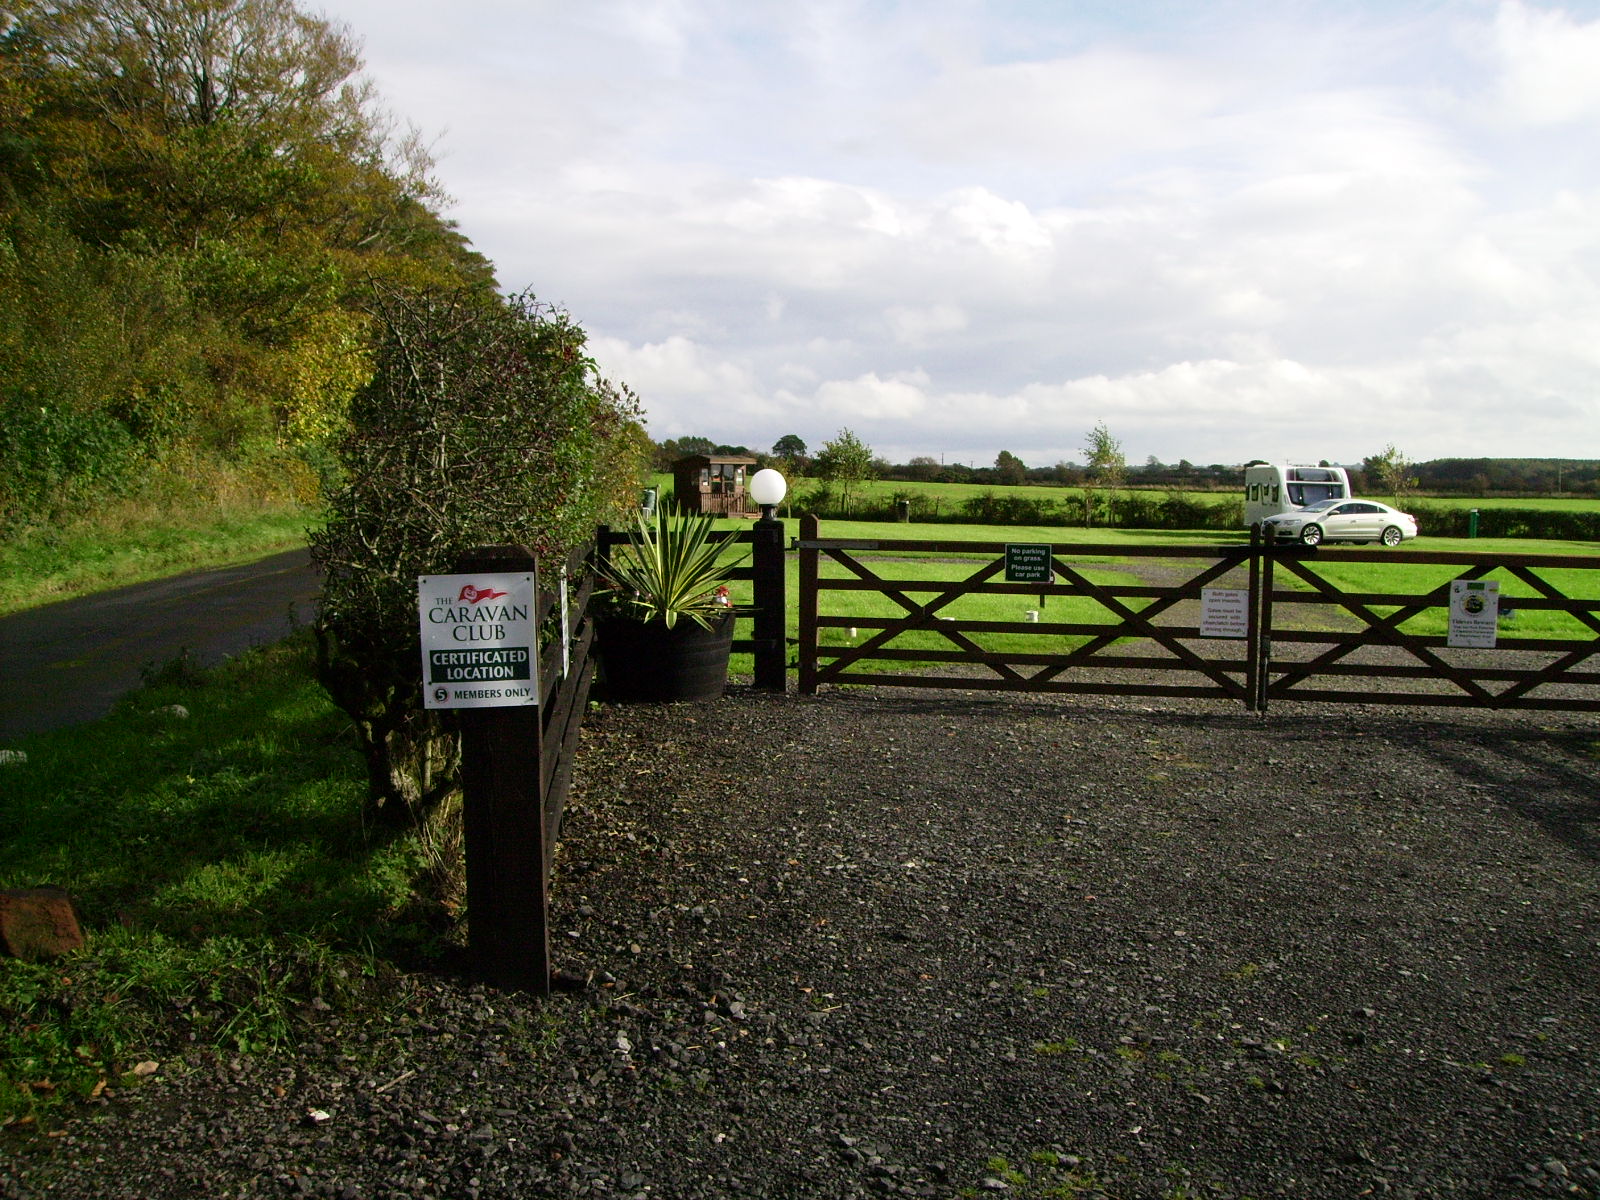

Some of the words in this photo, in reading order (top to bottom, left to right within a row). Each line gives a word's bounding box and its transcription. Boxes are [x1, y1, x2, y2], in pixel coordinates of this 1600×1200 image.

[1022, 548, 1046, 556] parking
[435, 597, 453, 606] THE
[428, 604, 528, 624] CARAVAN
[452, 624, 506, 642] CLUB
[432, 650, 527, 665] CERTIFICATED
[447, 666, 514, 680] LOCATION
[454, 689, 502, 700] MEMBERS
[505, 687, 531, 698] ONLY
